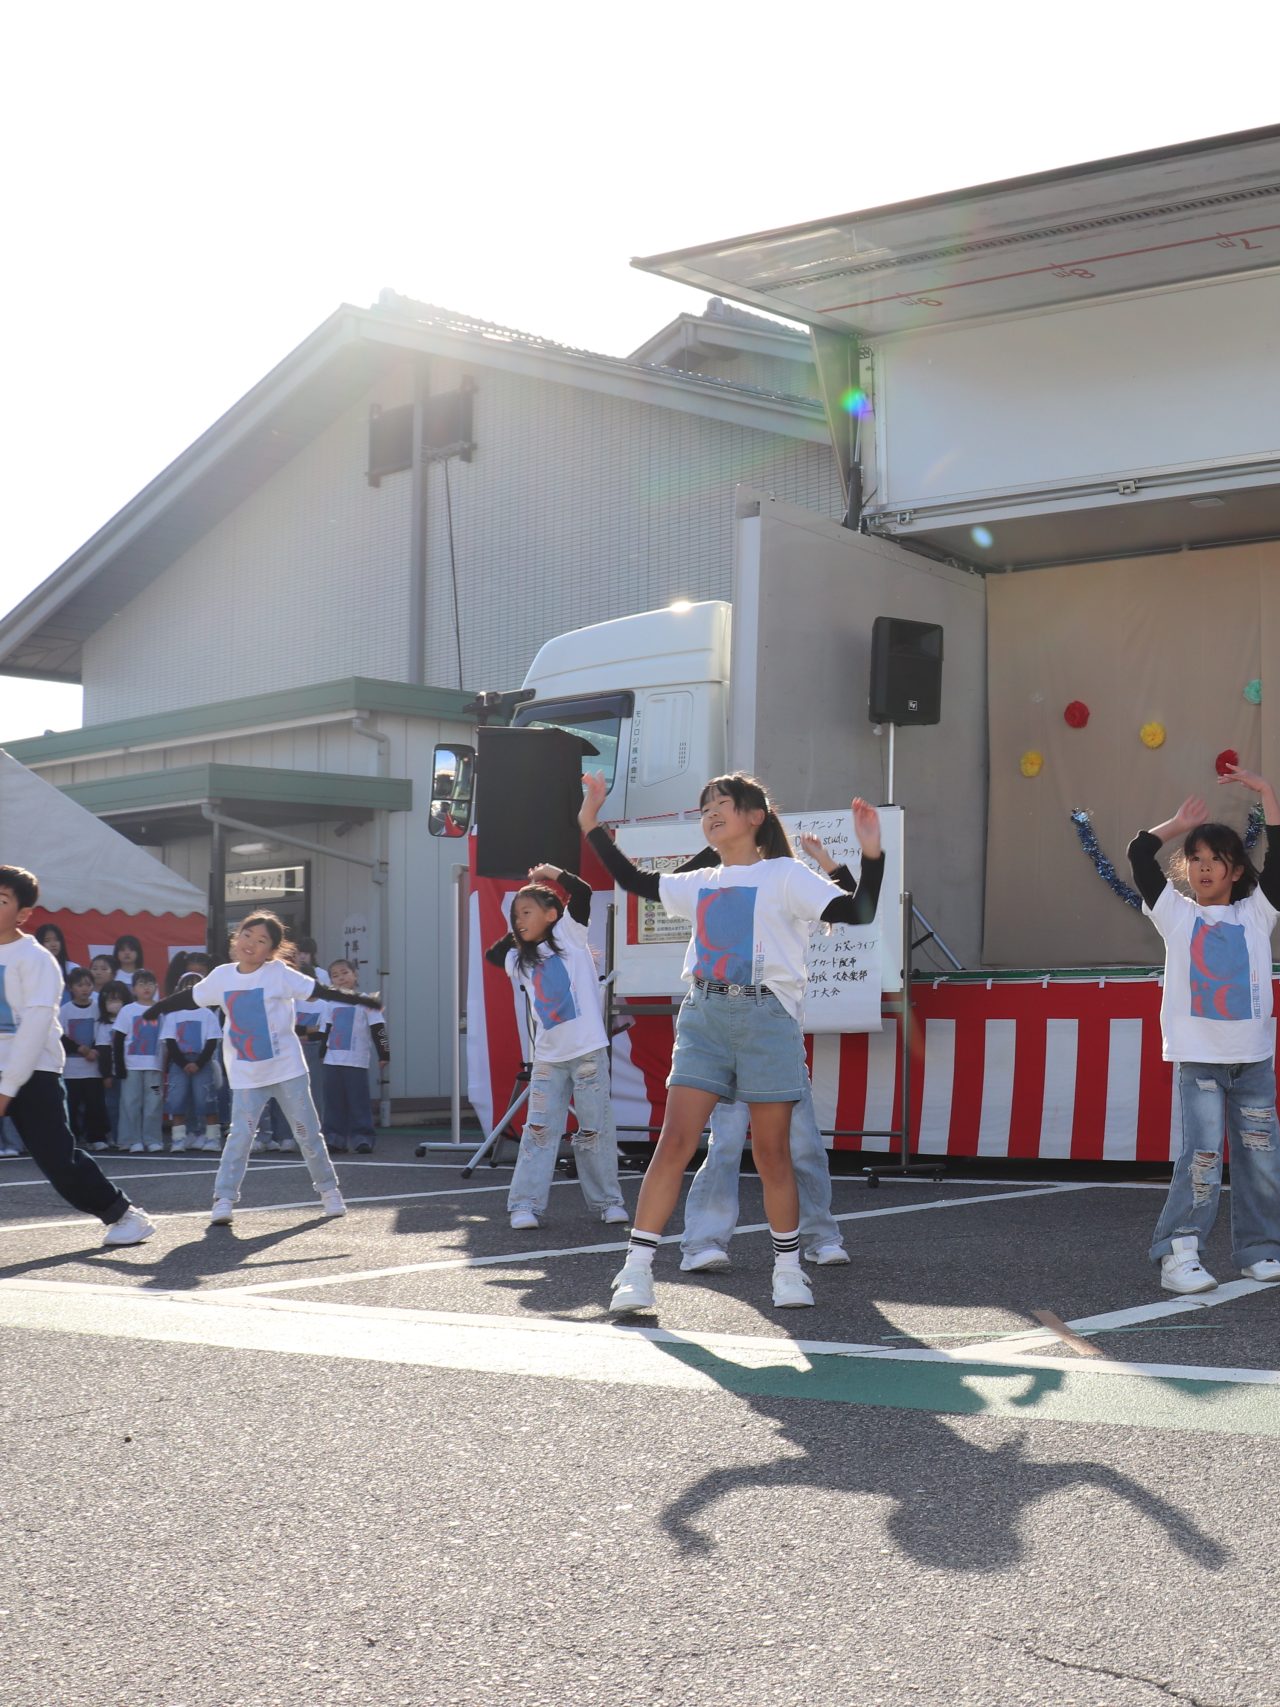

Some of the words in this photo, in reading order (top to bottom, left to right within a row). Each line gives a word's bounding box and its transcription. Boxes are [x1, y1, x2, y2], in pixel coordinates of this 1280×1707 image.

[1216, 238, 1263, 250] 7m
[1054, 268, 1096, 279] 8m
[823, 832, 849, 846] studio
[807, 957, 857, 968] ゴカード配布
[804, 987, 841, 998] ゴ大会
